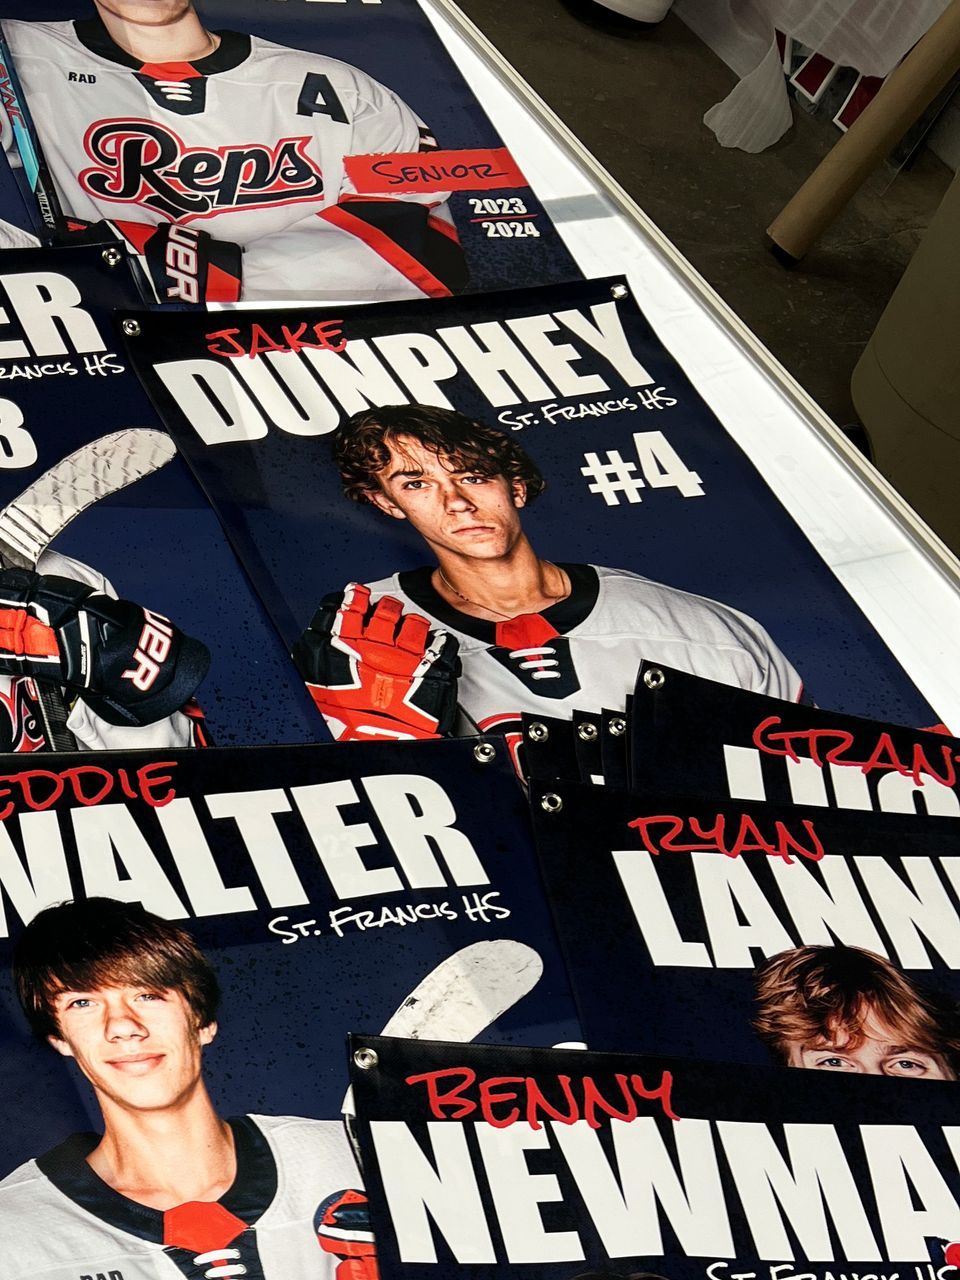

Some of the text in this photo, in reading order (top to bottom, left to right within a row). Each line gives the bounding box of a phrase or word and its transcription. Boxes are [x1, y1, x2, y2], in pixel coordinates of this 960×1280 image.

[68, 71, 97, 86] RAD
[296, 72, 350, 125] A
[77, 116, 325, 221] Reps
[372, 160, 511, 184] SENIOR
[468, 198, 527, 216] 2023
[481, 221, 540, 238] 2024
[205, 319, 349, 359] JAKE
[84, 354, 126, 377] HS
[151, 301, 655, 446] DUNPHEY
[541, 396, 638, 426] FRANCIS
[642, 386, 678, 410] HS
[580, 430, 706, 507] #4
[752, 716, 960, 787] GRAN
[627, 813, 825, 865] RYAN
[329, 902, 459, 939] FRANCIS
[464, 892, 512, 923] HS
[611, 850, 960, 970] LANN
[405, 1066, 681, 1130] BENNY
[368, 1116, 960, 1265] NEWMA
